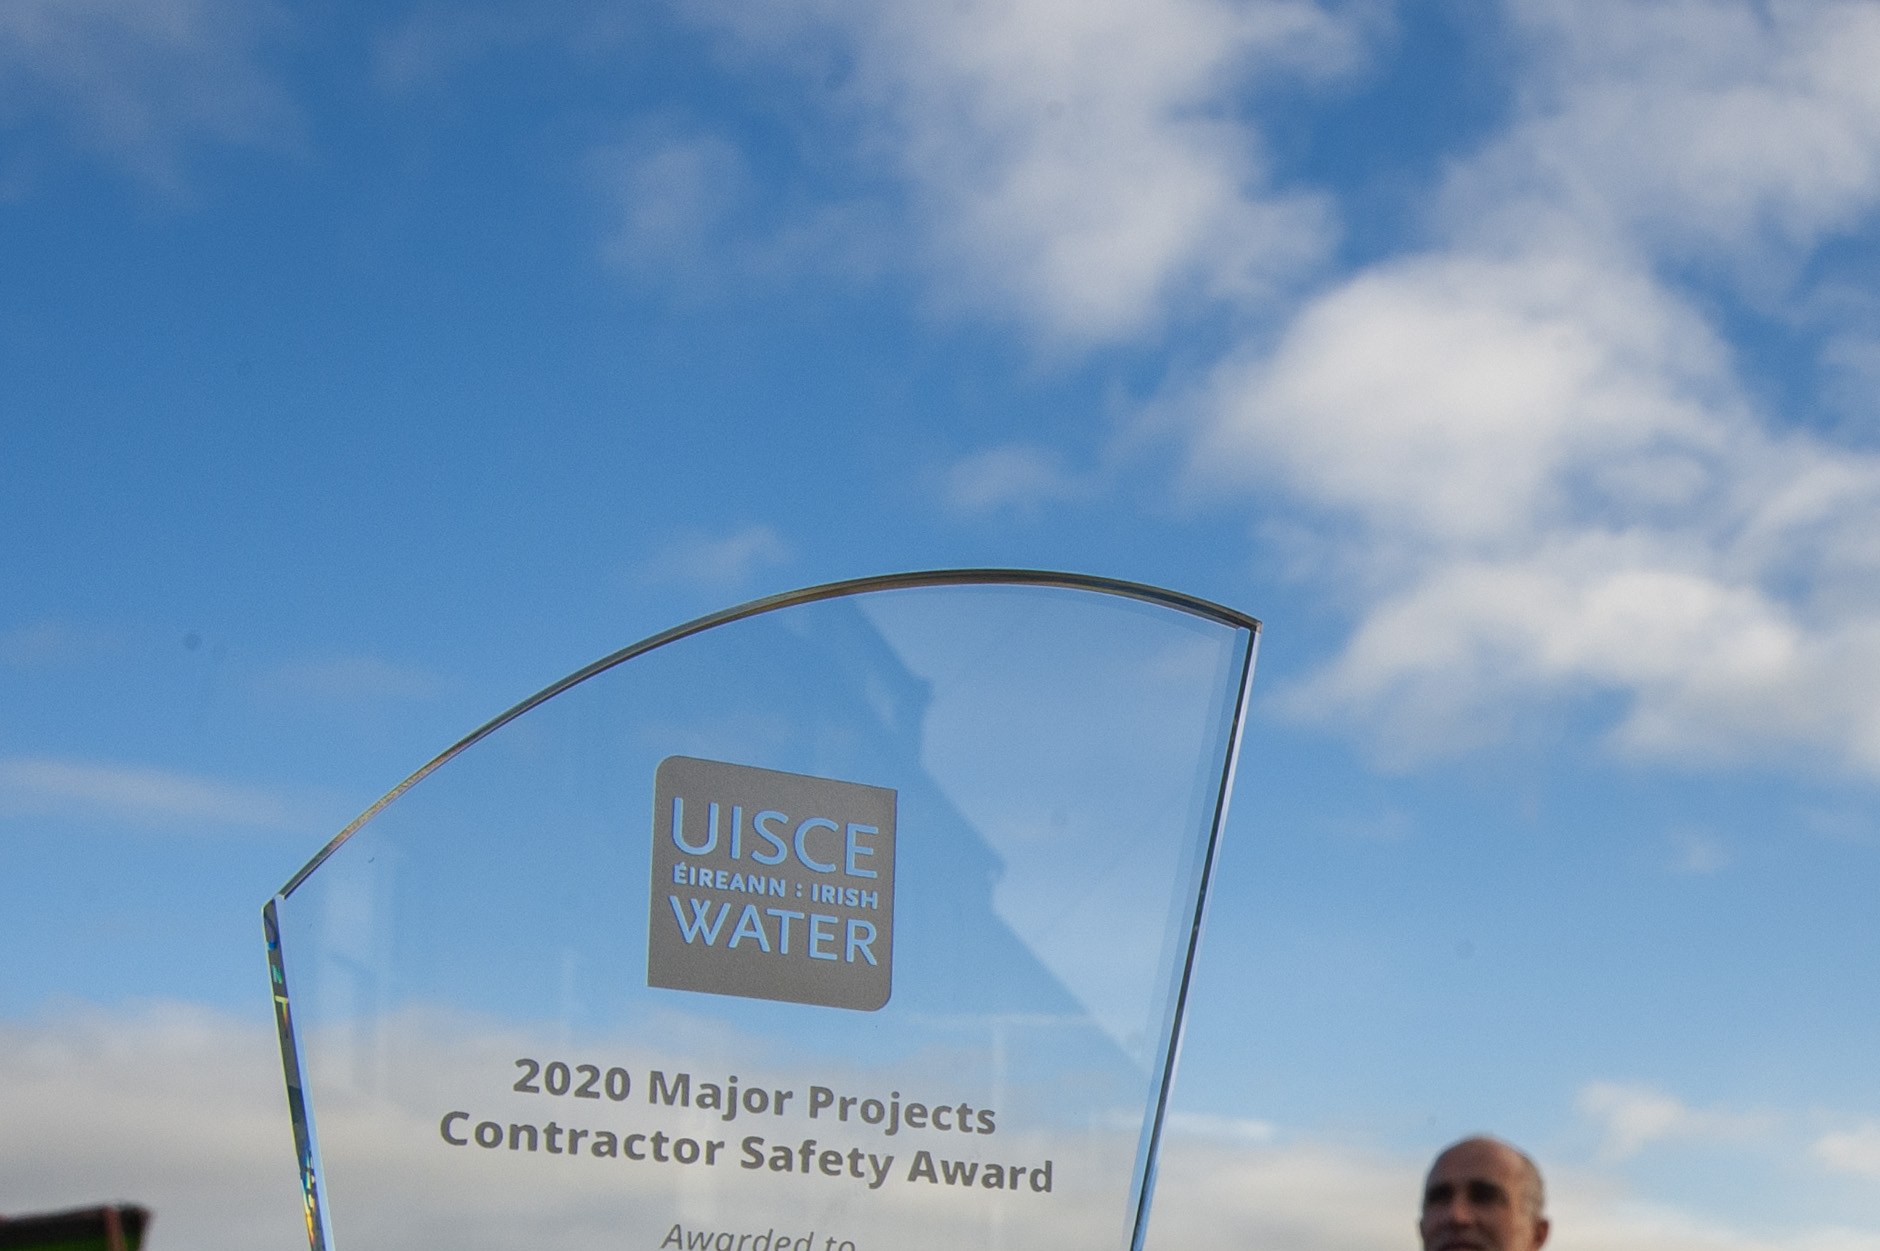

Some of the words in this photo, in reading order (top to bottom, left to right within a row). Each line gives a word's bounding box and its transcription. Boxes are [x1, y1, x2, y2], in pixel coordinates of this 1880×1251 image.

[672, 797, 879, 879] UISCE
[673, 861, 786, 898] ÉIREANN
[811, 883, 878, 910] IRISH
[668, 895, 878, 966] WATER
[513, 1057, 631, 1103] 2020
[648, 1070, 794, 1121] Major
[808, 1085, 997, 1136] Projects
[439, 1110, 725, 1166] Contractor
[740, 1134, 895, 1190] Safety
[907, 1150, 1054, 1194] Award
